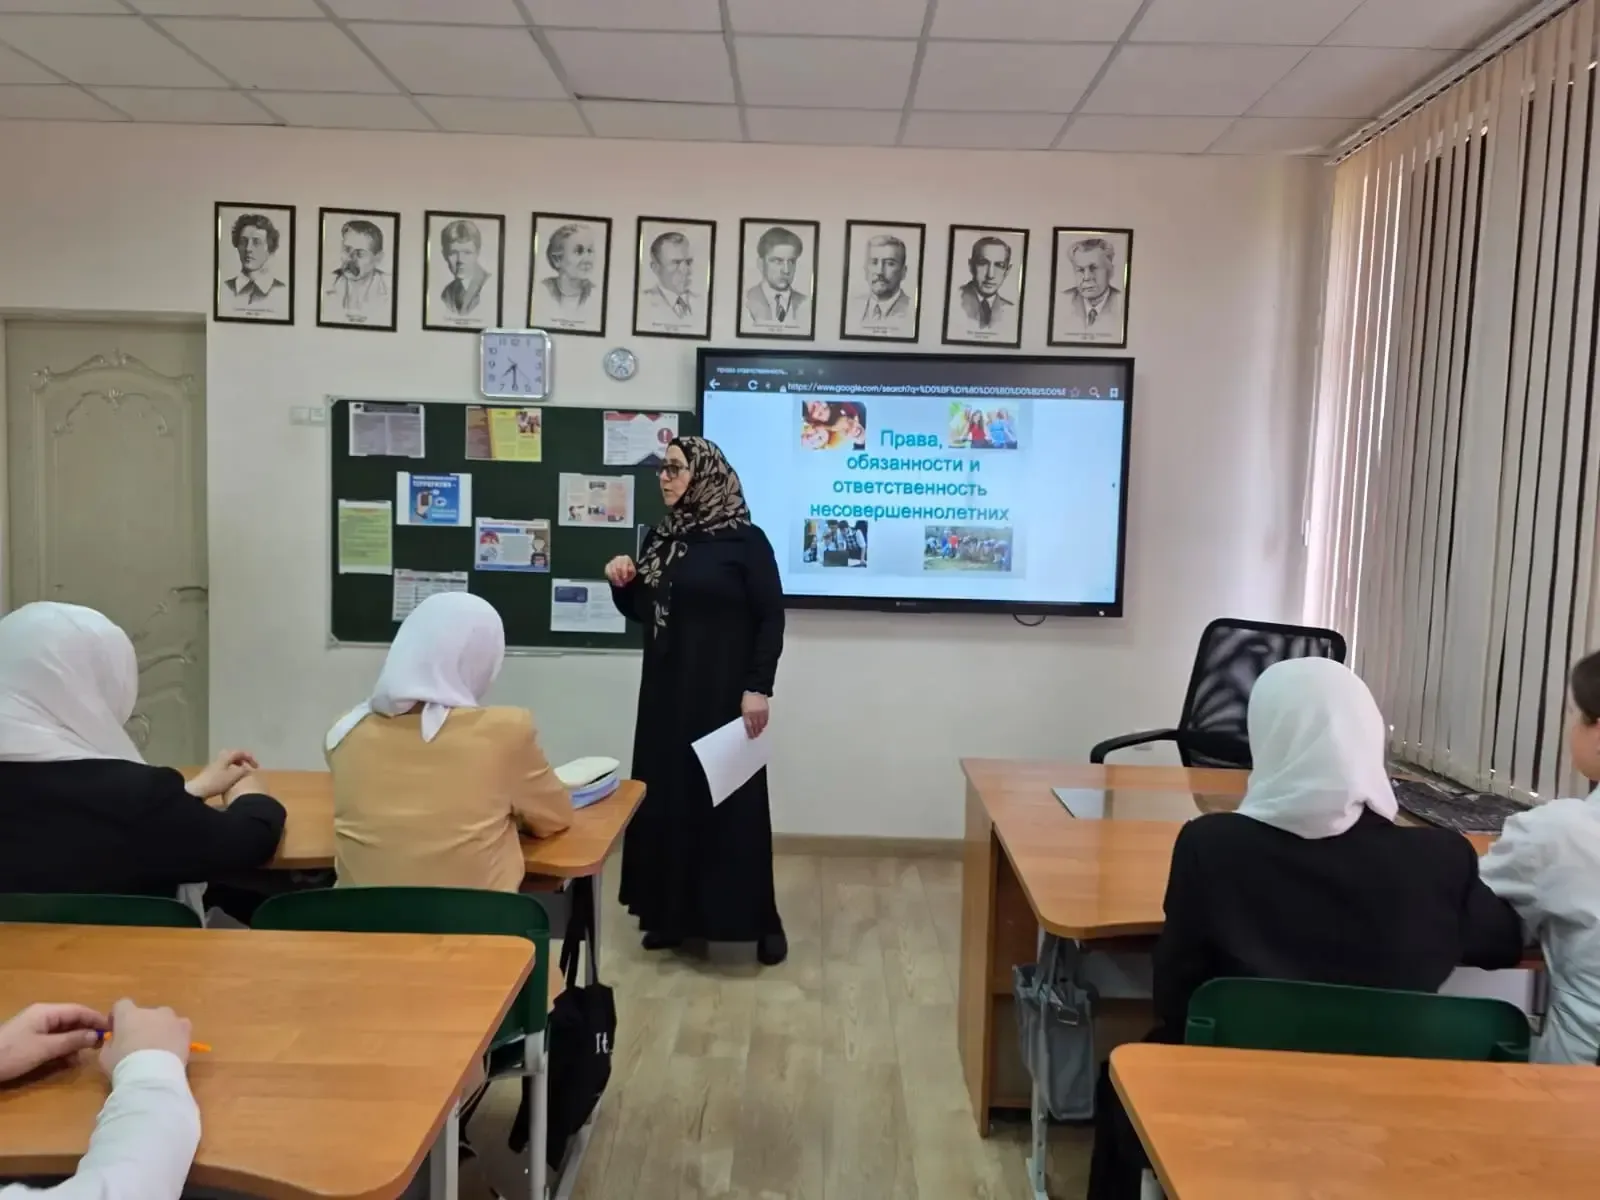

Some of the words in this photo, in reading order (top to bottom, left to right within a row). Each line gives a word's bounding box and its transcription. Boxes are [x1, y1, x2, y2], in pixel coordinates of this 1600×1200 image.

[880, 429, 943, 449] Права,
[846, 453, 963, 472] обязанности
[969, 459, 981, 472] и
[832, 479, 988, 496] ответственность
[810, 503, 1009, 521] несовершеннолетних
